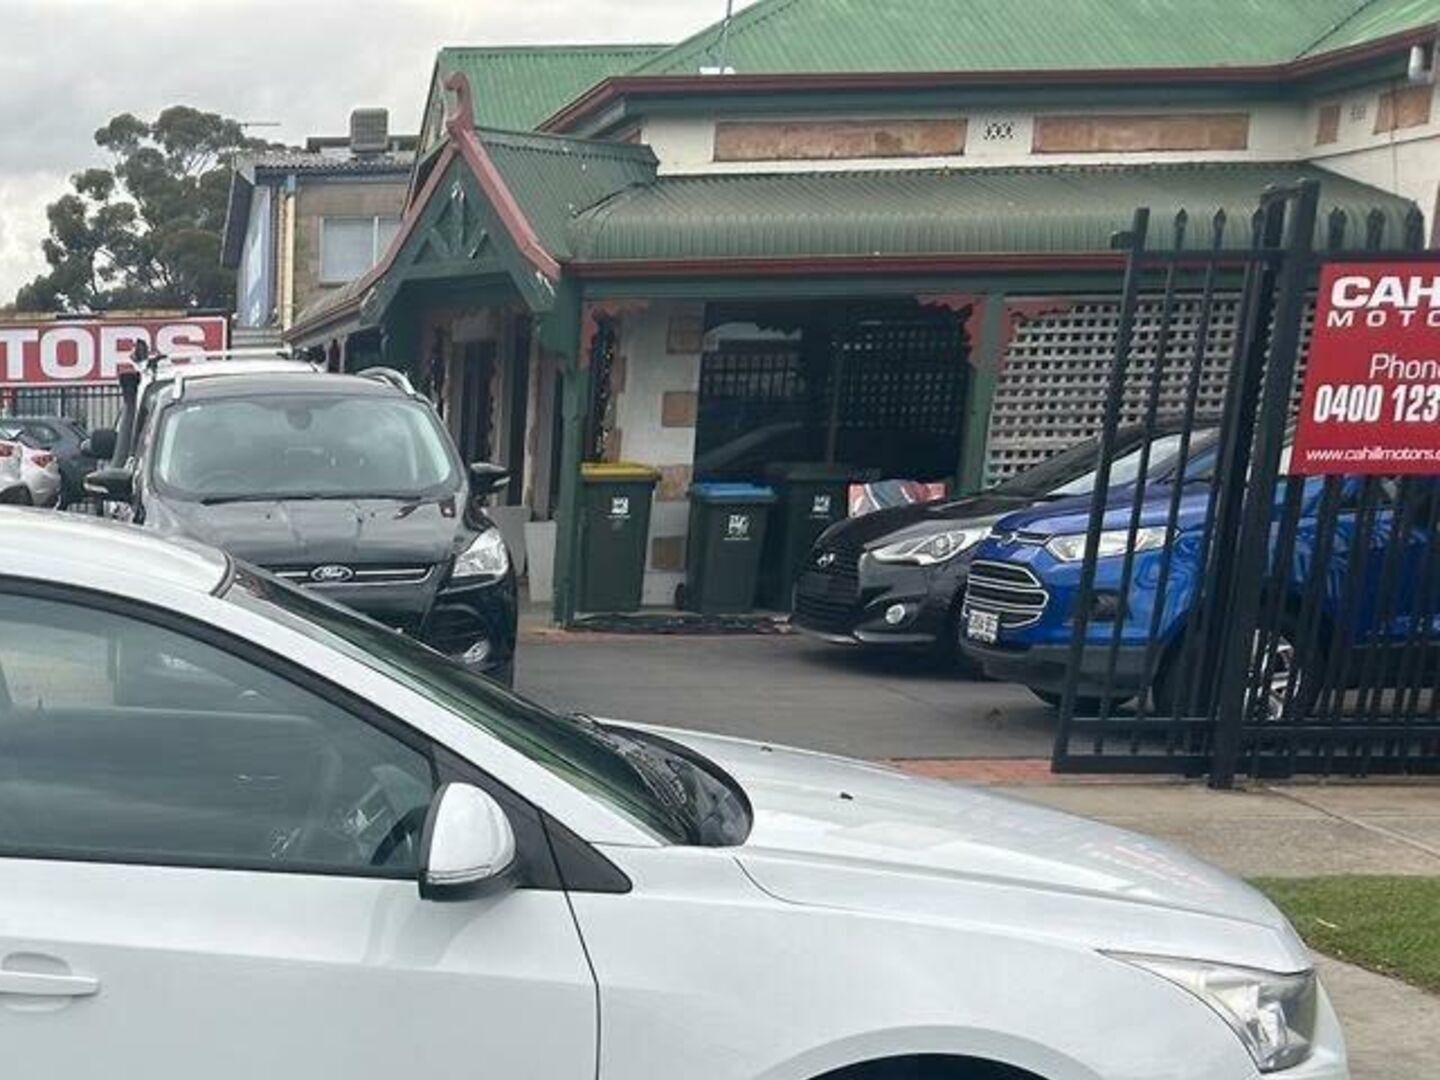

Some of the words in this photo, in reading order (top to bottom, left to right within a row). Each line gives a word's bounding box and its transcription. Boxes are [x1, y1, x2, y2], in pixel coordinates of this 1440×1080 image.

[1369, 353, 1440, 379] Phon
[1313, 384, 1384, 423] 0400
[1391, 384, 1440, 422] 123
